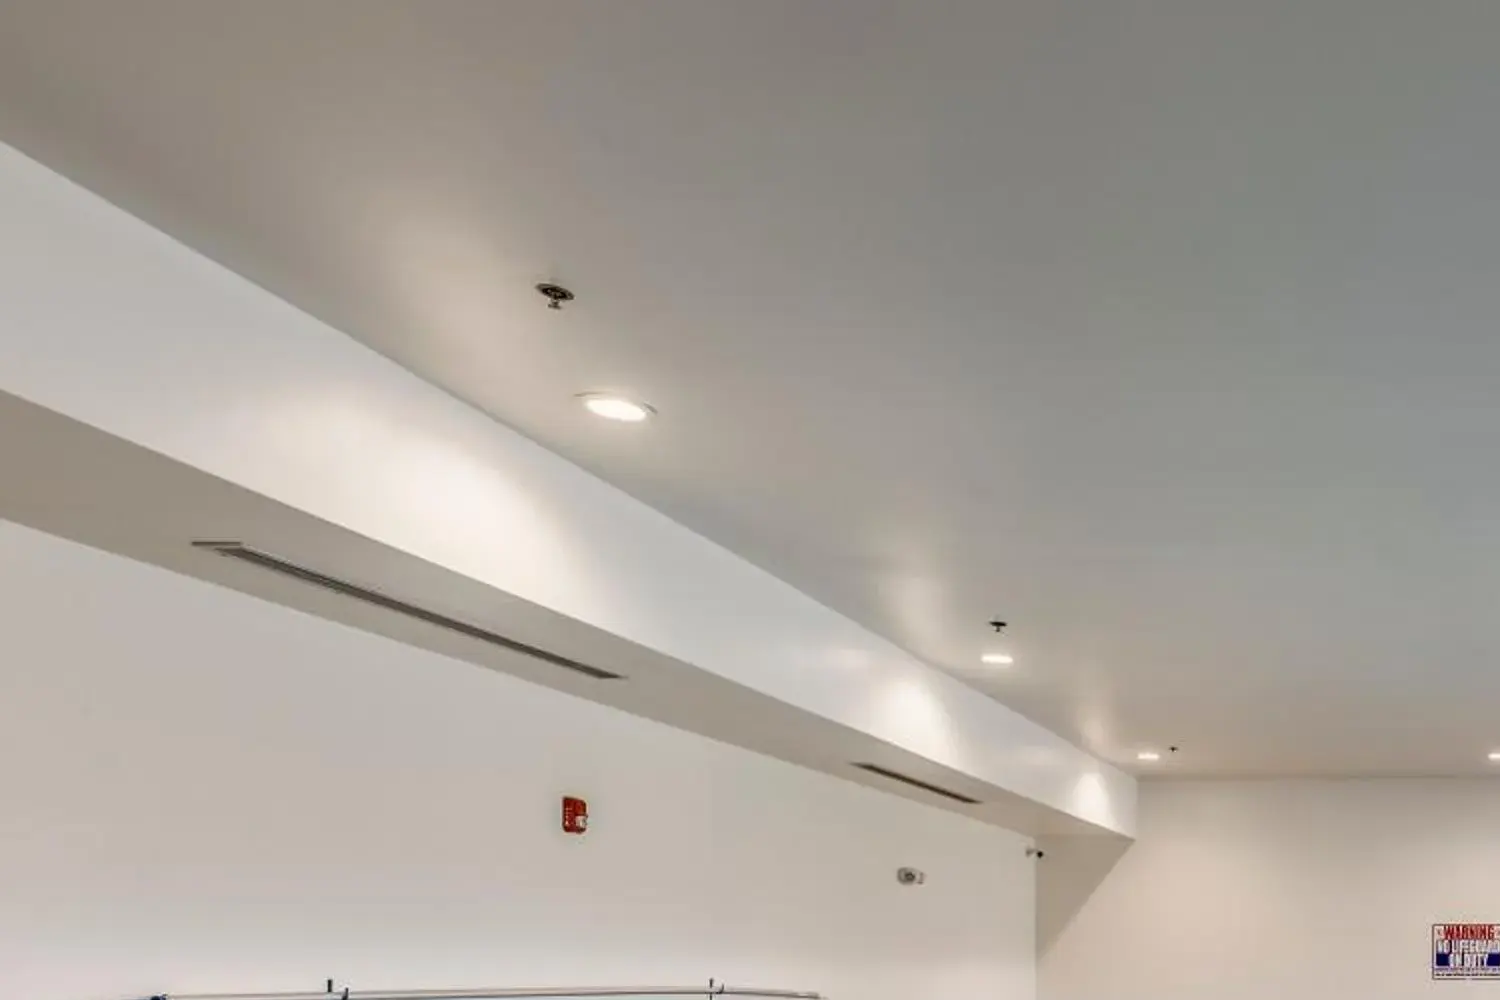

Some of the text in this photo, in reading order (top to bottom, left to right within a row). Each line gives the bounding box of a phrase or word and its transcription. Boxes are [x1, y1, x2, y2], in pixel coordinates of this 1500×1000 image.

[1443, 925, 1495, 940] WARNING
[1437, 940, 1500, 953] NO LIFEGUARD
[1464, 954, 1489, 967] DUTY
